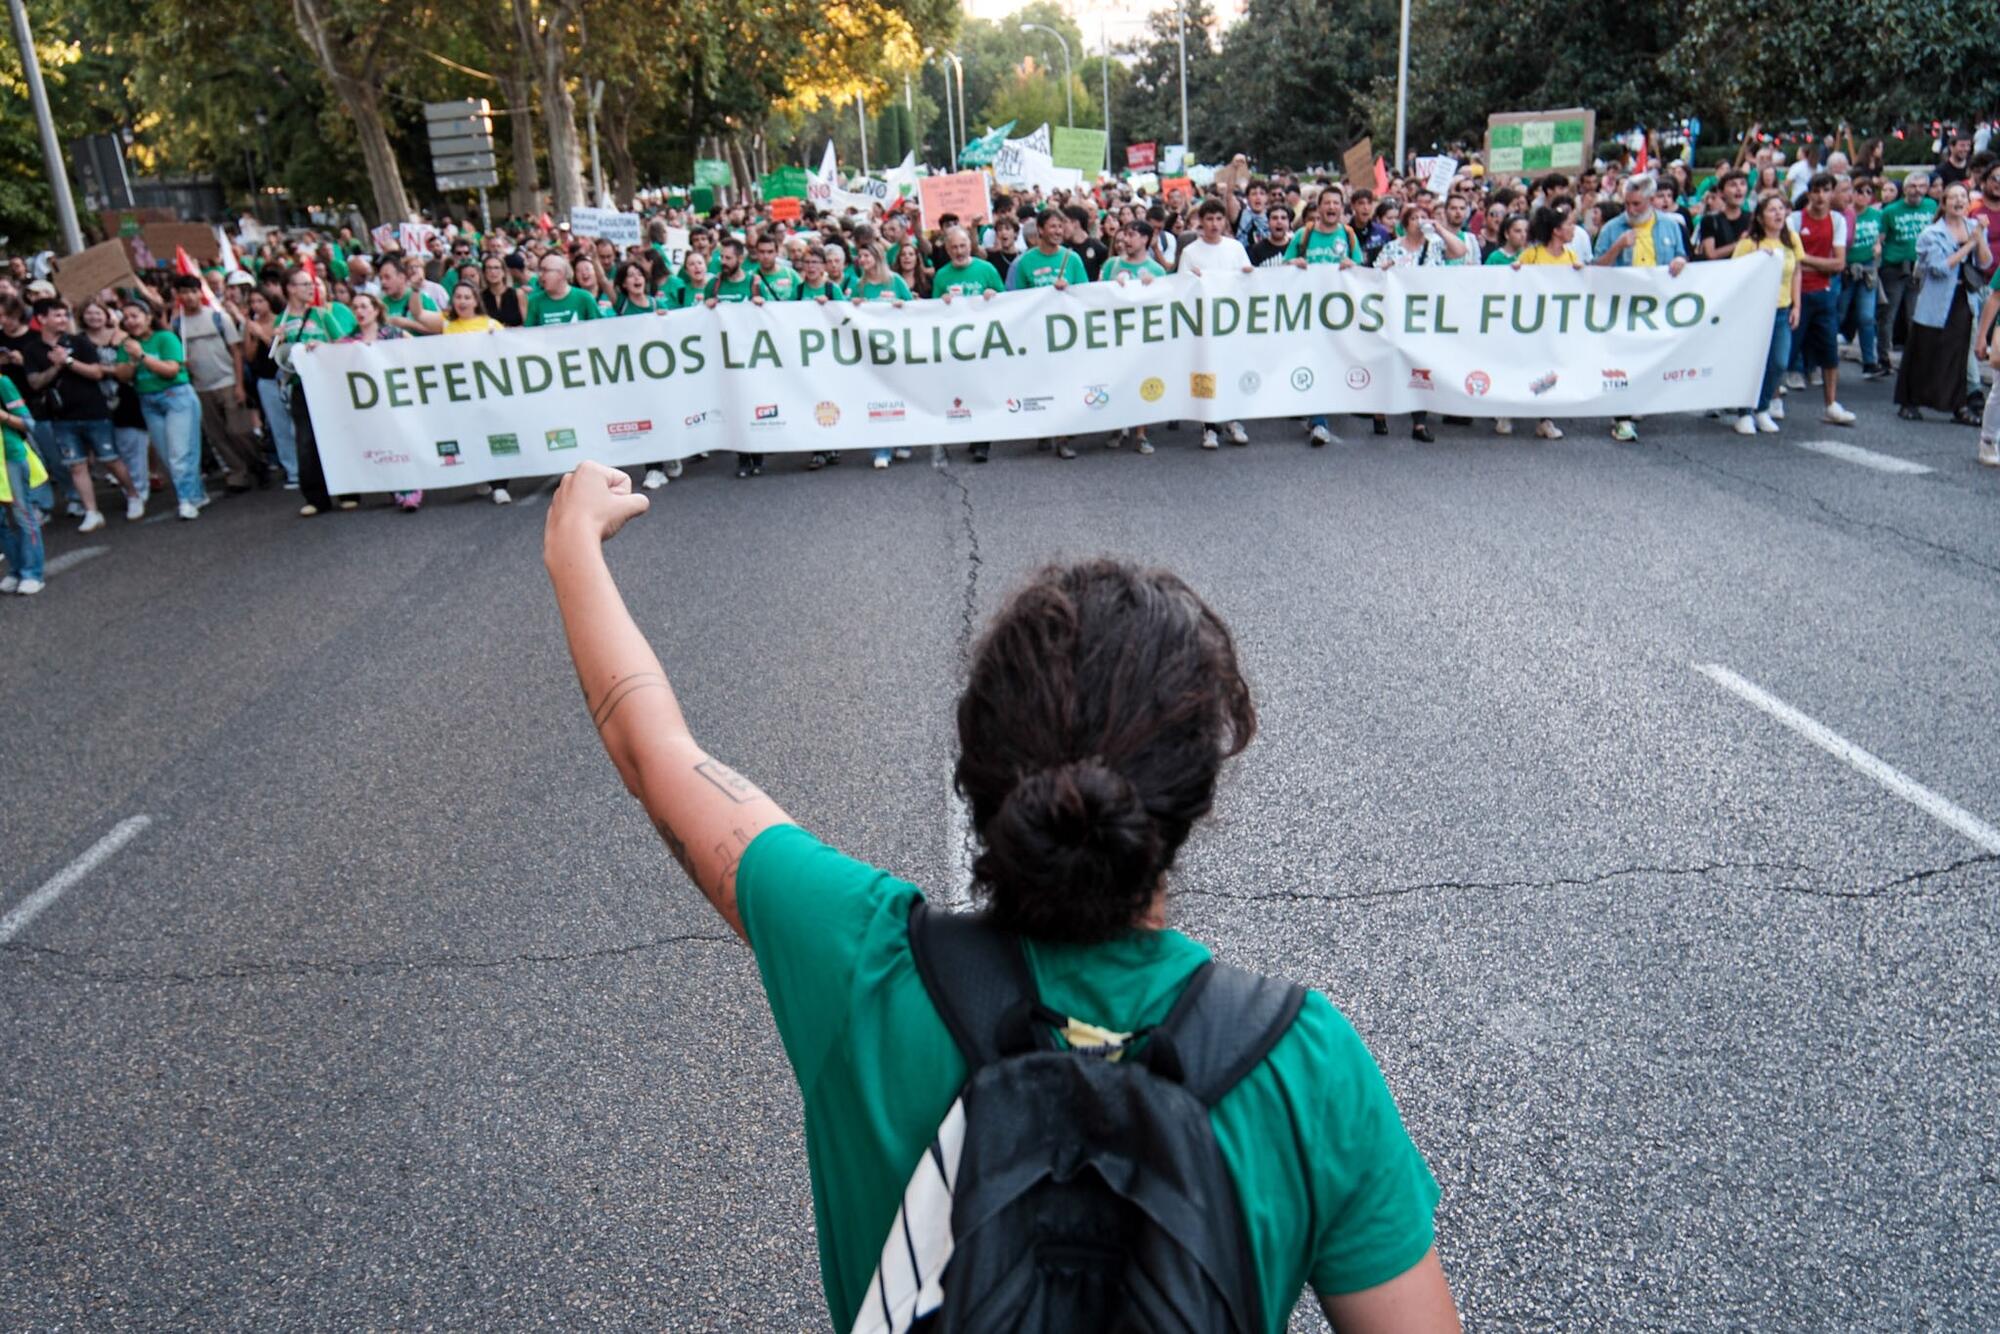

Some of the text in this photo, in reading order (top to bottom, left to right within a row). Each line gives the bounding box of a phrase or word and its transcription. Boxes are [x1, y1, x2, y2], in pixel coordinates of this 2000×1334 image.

[865, 180, 887, 199] NO
[345, 291, 1721, 411] DEFENDEMOS LA PÚBLICA. DEFENDEMOS EL FUTURO.
[1663, 370, 1687, 381] UGT
[1602, 380, 1629, 389] STEM
[684, 411, 707, 426] CGT
